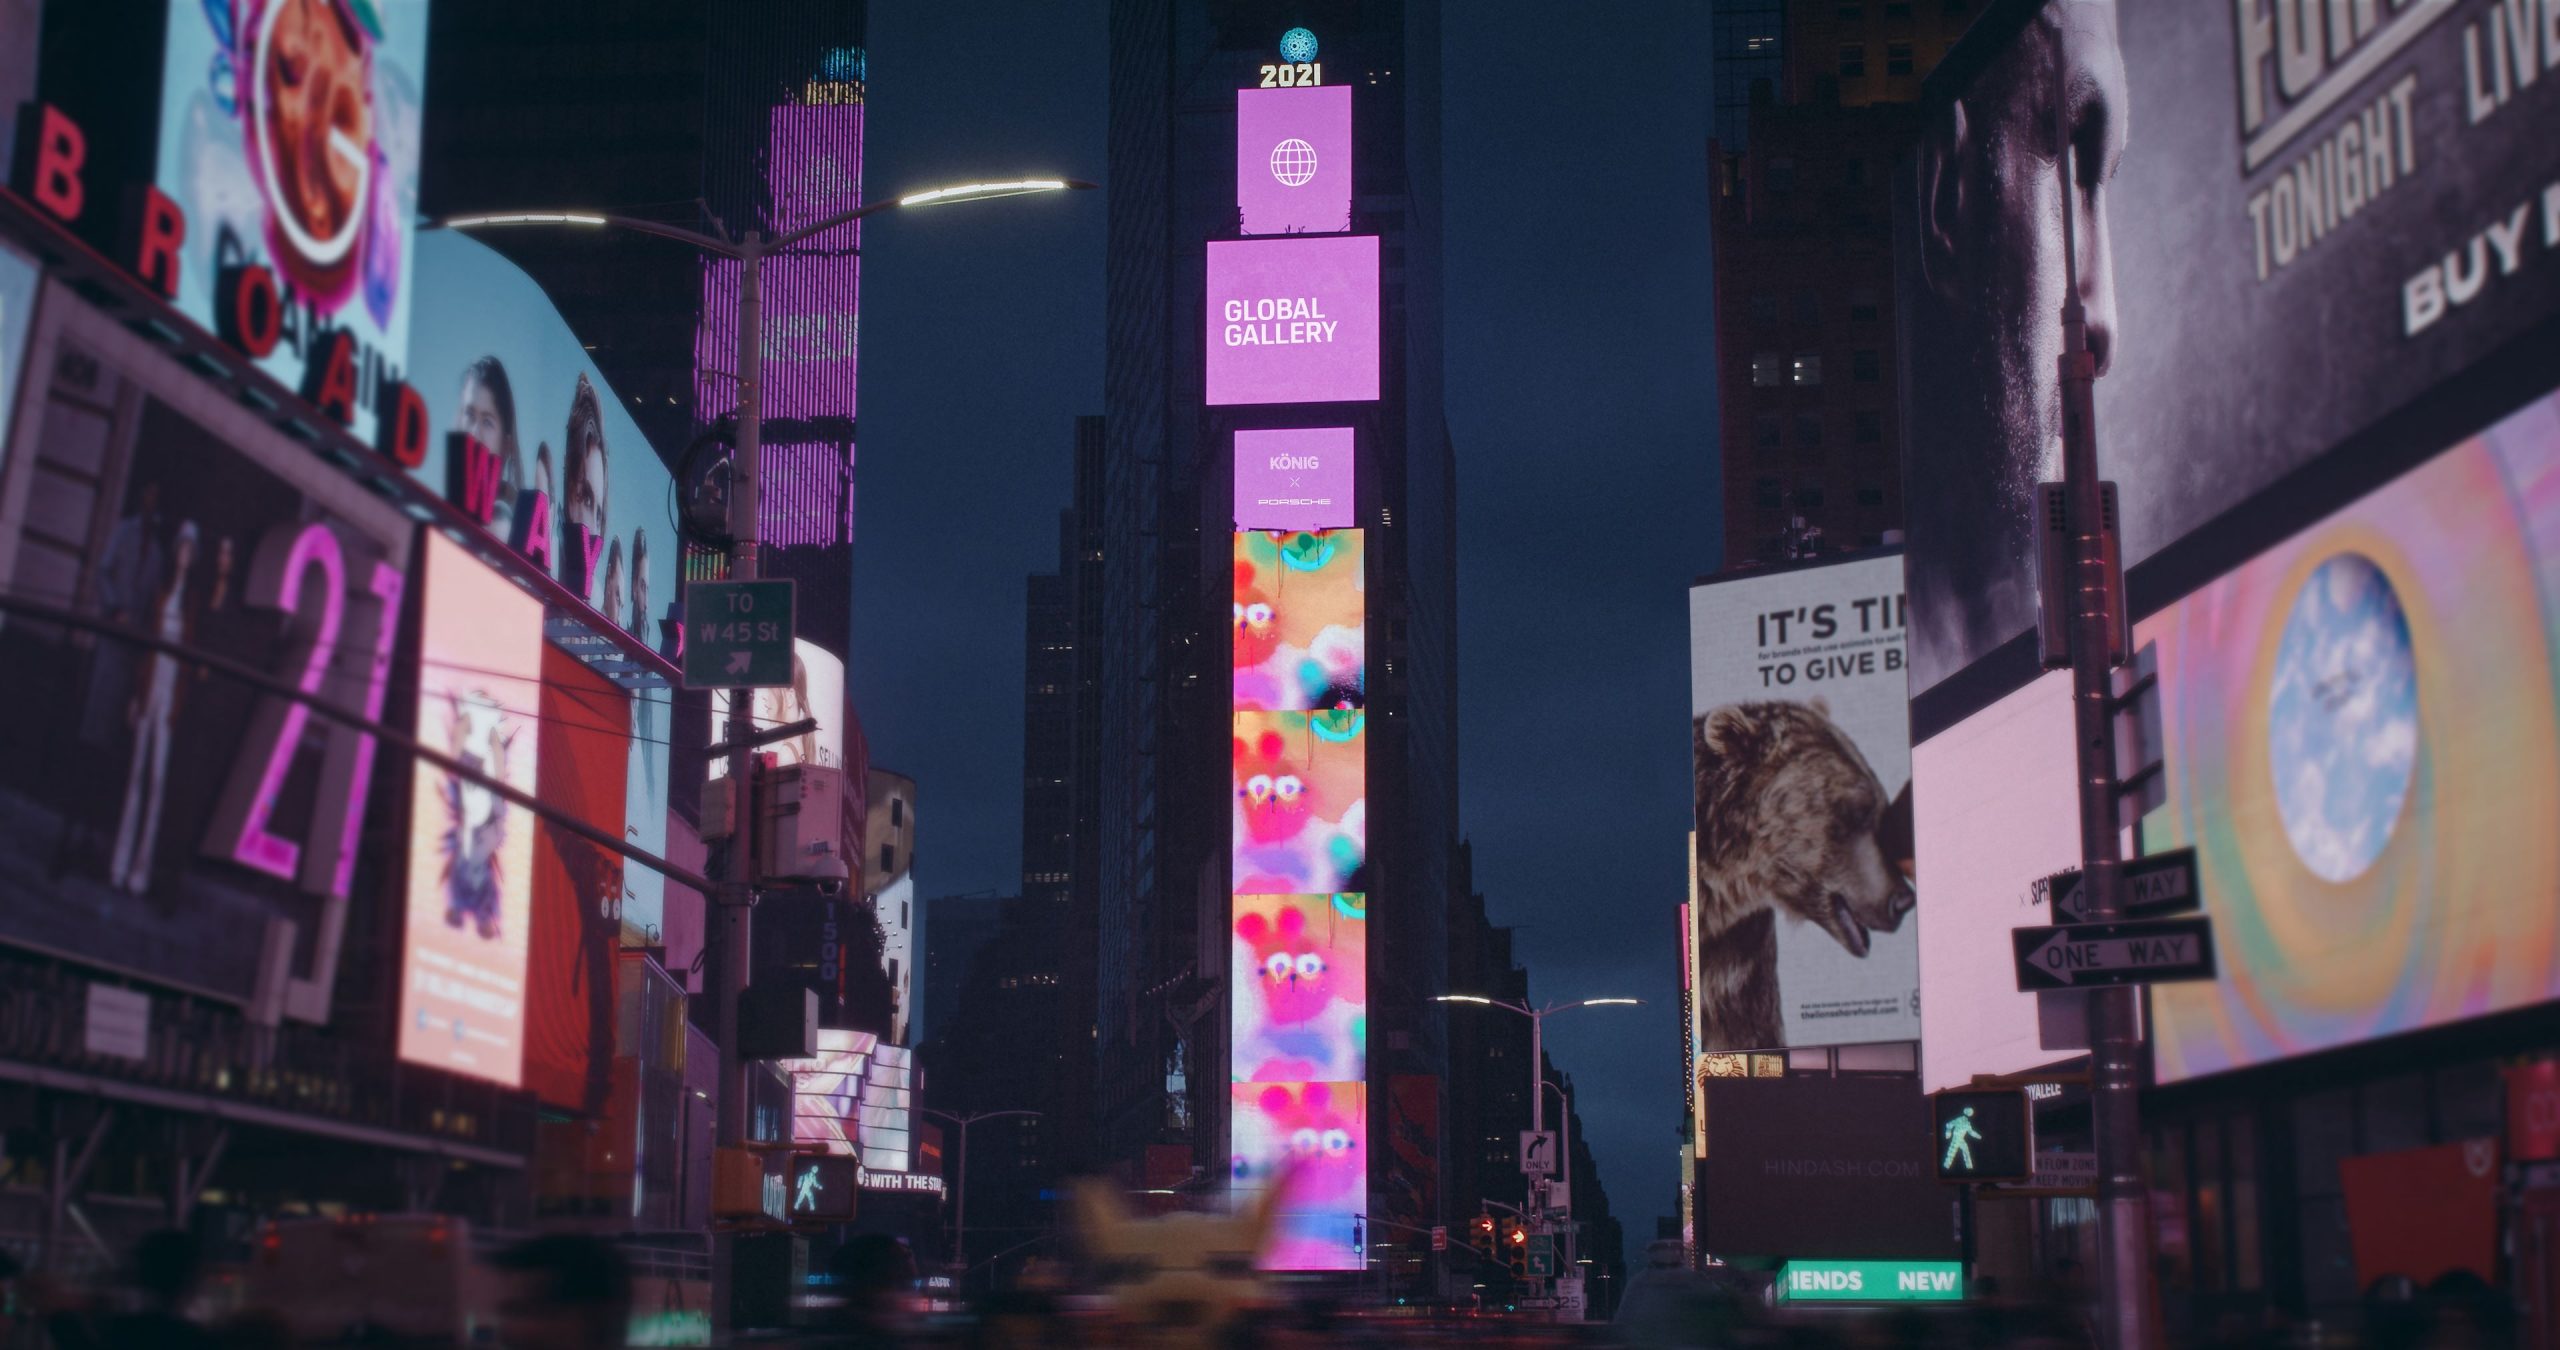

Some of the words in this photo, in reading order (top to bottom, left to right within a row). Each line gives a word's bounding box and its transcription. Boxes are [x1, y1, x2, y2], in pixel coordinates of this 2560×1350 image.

[1260, 63, 1321, 88] 2021
[2249, 71, 2418, 282] TONIGHT
[2402, 200, 2532, 338] BUY
[1224, 297, 1326, 322] GLOBAL
[1224, 320, 1338, 347] GALLERY
[1269, 453, 1319, 470] KÖNIG
[1258, 498, 1331, 506] PORSCHE
[726, 592, 754, 613] TO
[1758, 603, 1838, 647] IT'S
[1852, 595, 1907, 633] TI
[701, 623, 717, 643] W
[721, 622, 752, 643] 45
[757, 621, 779, 642] St
[1758, 663, 1797, 688] TO
[1806, 651, 1875, 681] GIVE
[1884, 648, 1908, 672] B
[2134, 870, 2176, 900] WAY
[2046, 942, 2102, 970] ONE
[2127, 937, 2185, 964] WAY
[1526, 1161, 1550, 1169] ONLY
[1764, 1159, 1920, 1178] HINDASH.COM
[2046, 1158, 2070, 1171] FLOW
[2072, 1158, 2097, 1171] ZONE
[870, 1174, 902, 1189] WITH
[905, 1175, 928, 1190] THE
[2036, 1175, 2059, 1187] KEEP
[1898, 1271, 1956, 1291] NEW
[1561, 1296, 1581, 1309] 25
